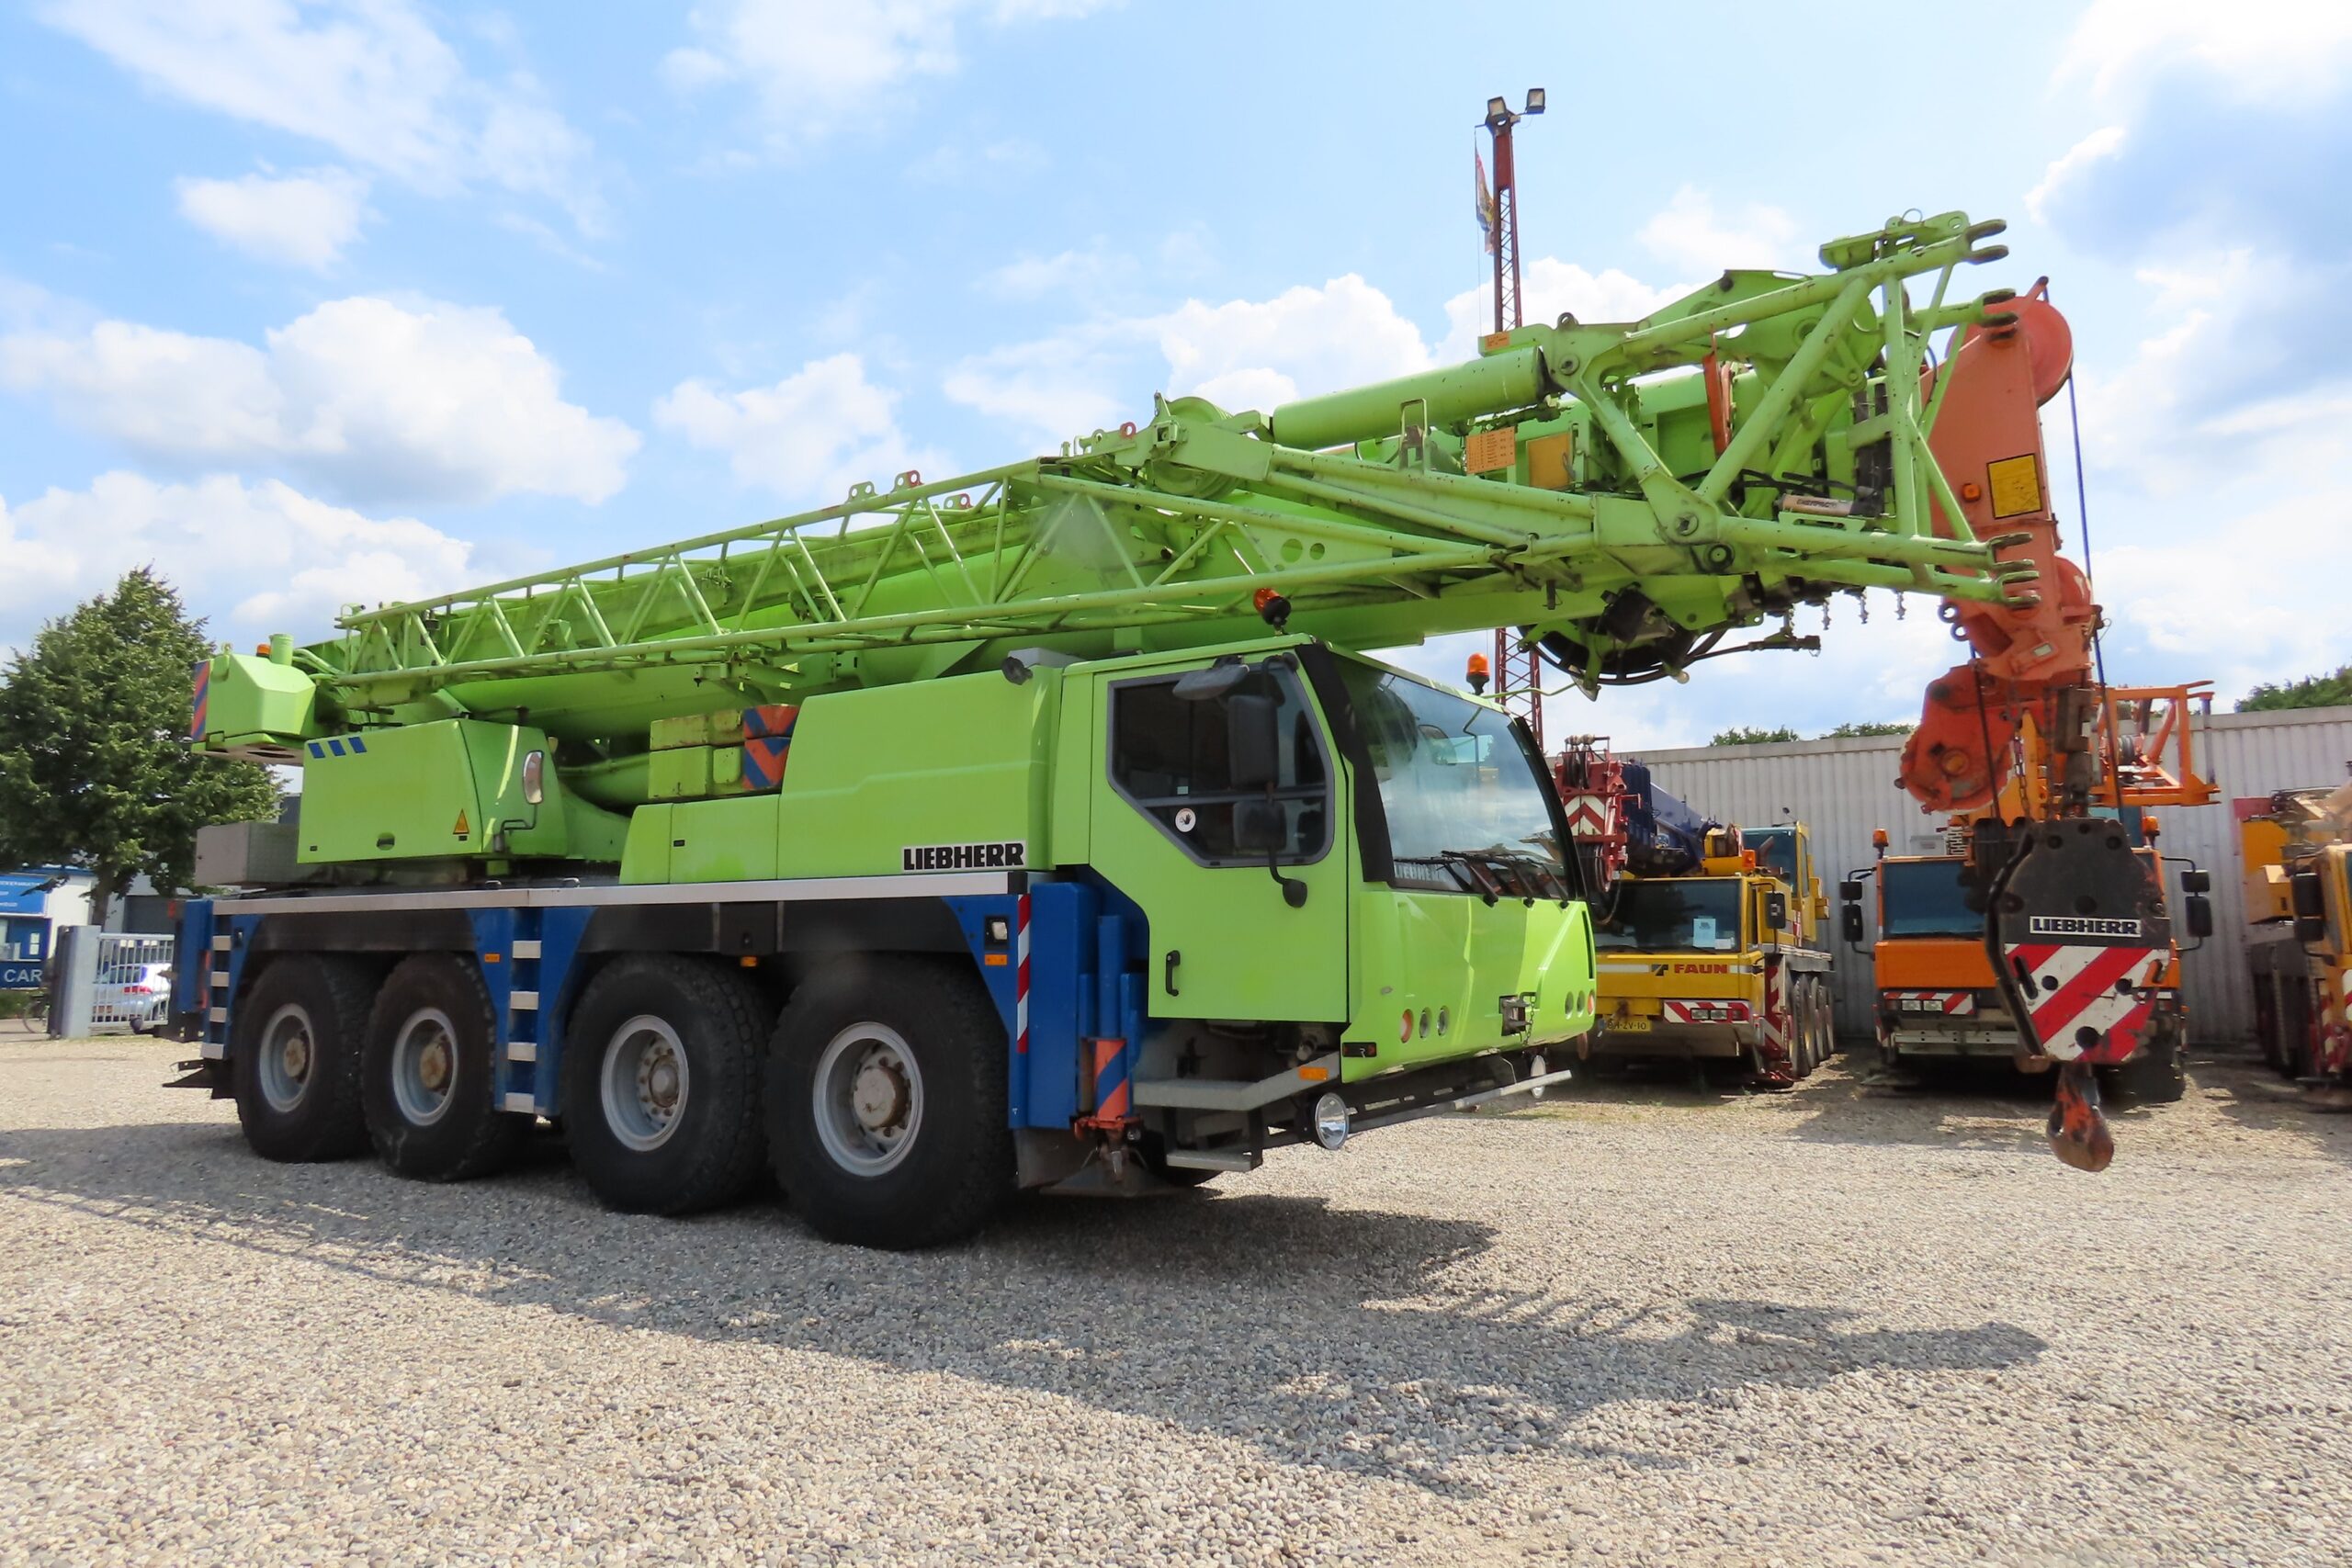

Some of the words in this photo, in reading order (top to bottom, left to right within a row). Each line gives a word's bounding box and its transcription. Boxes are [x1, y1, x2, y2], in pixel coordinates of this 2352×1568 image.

[904, 842, 1024, 871] LIEBHERR
[2033, 918, 2137, 934] LIEBHERR
[4, 968, 43, 983] CAR
[1674, 964, 1728, 975] FAUN
